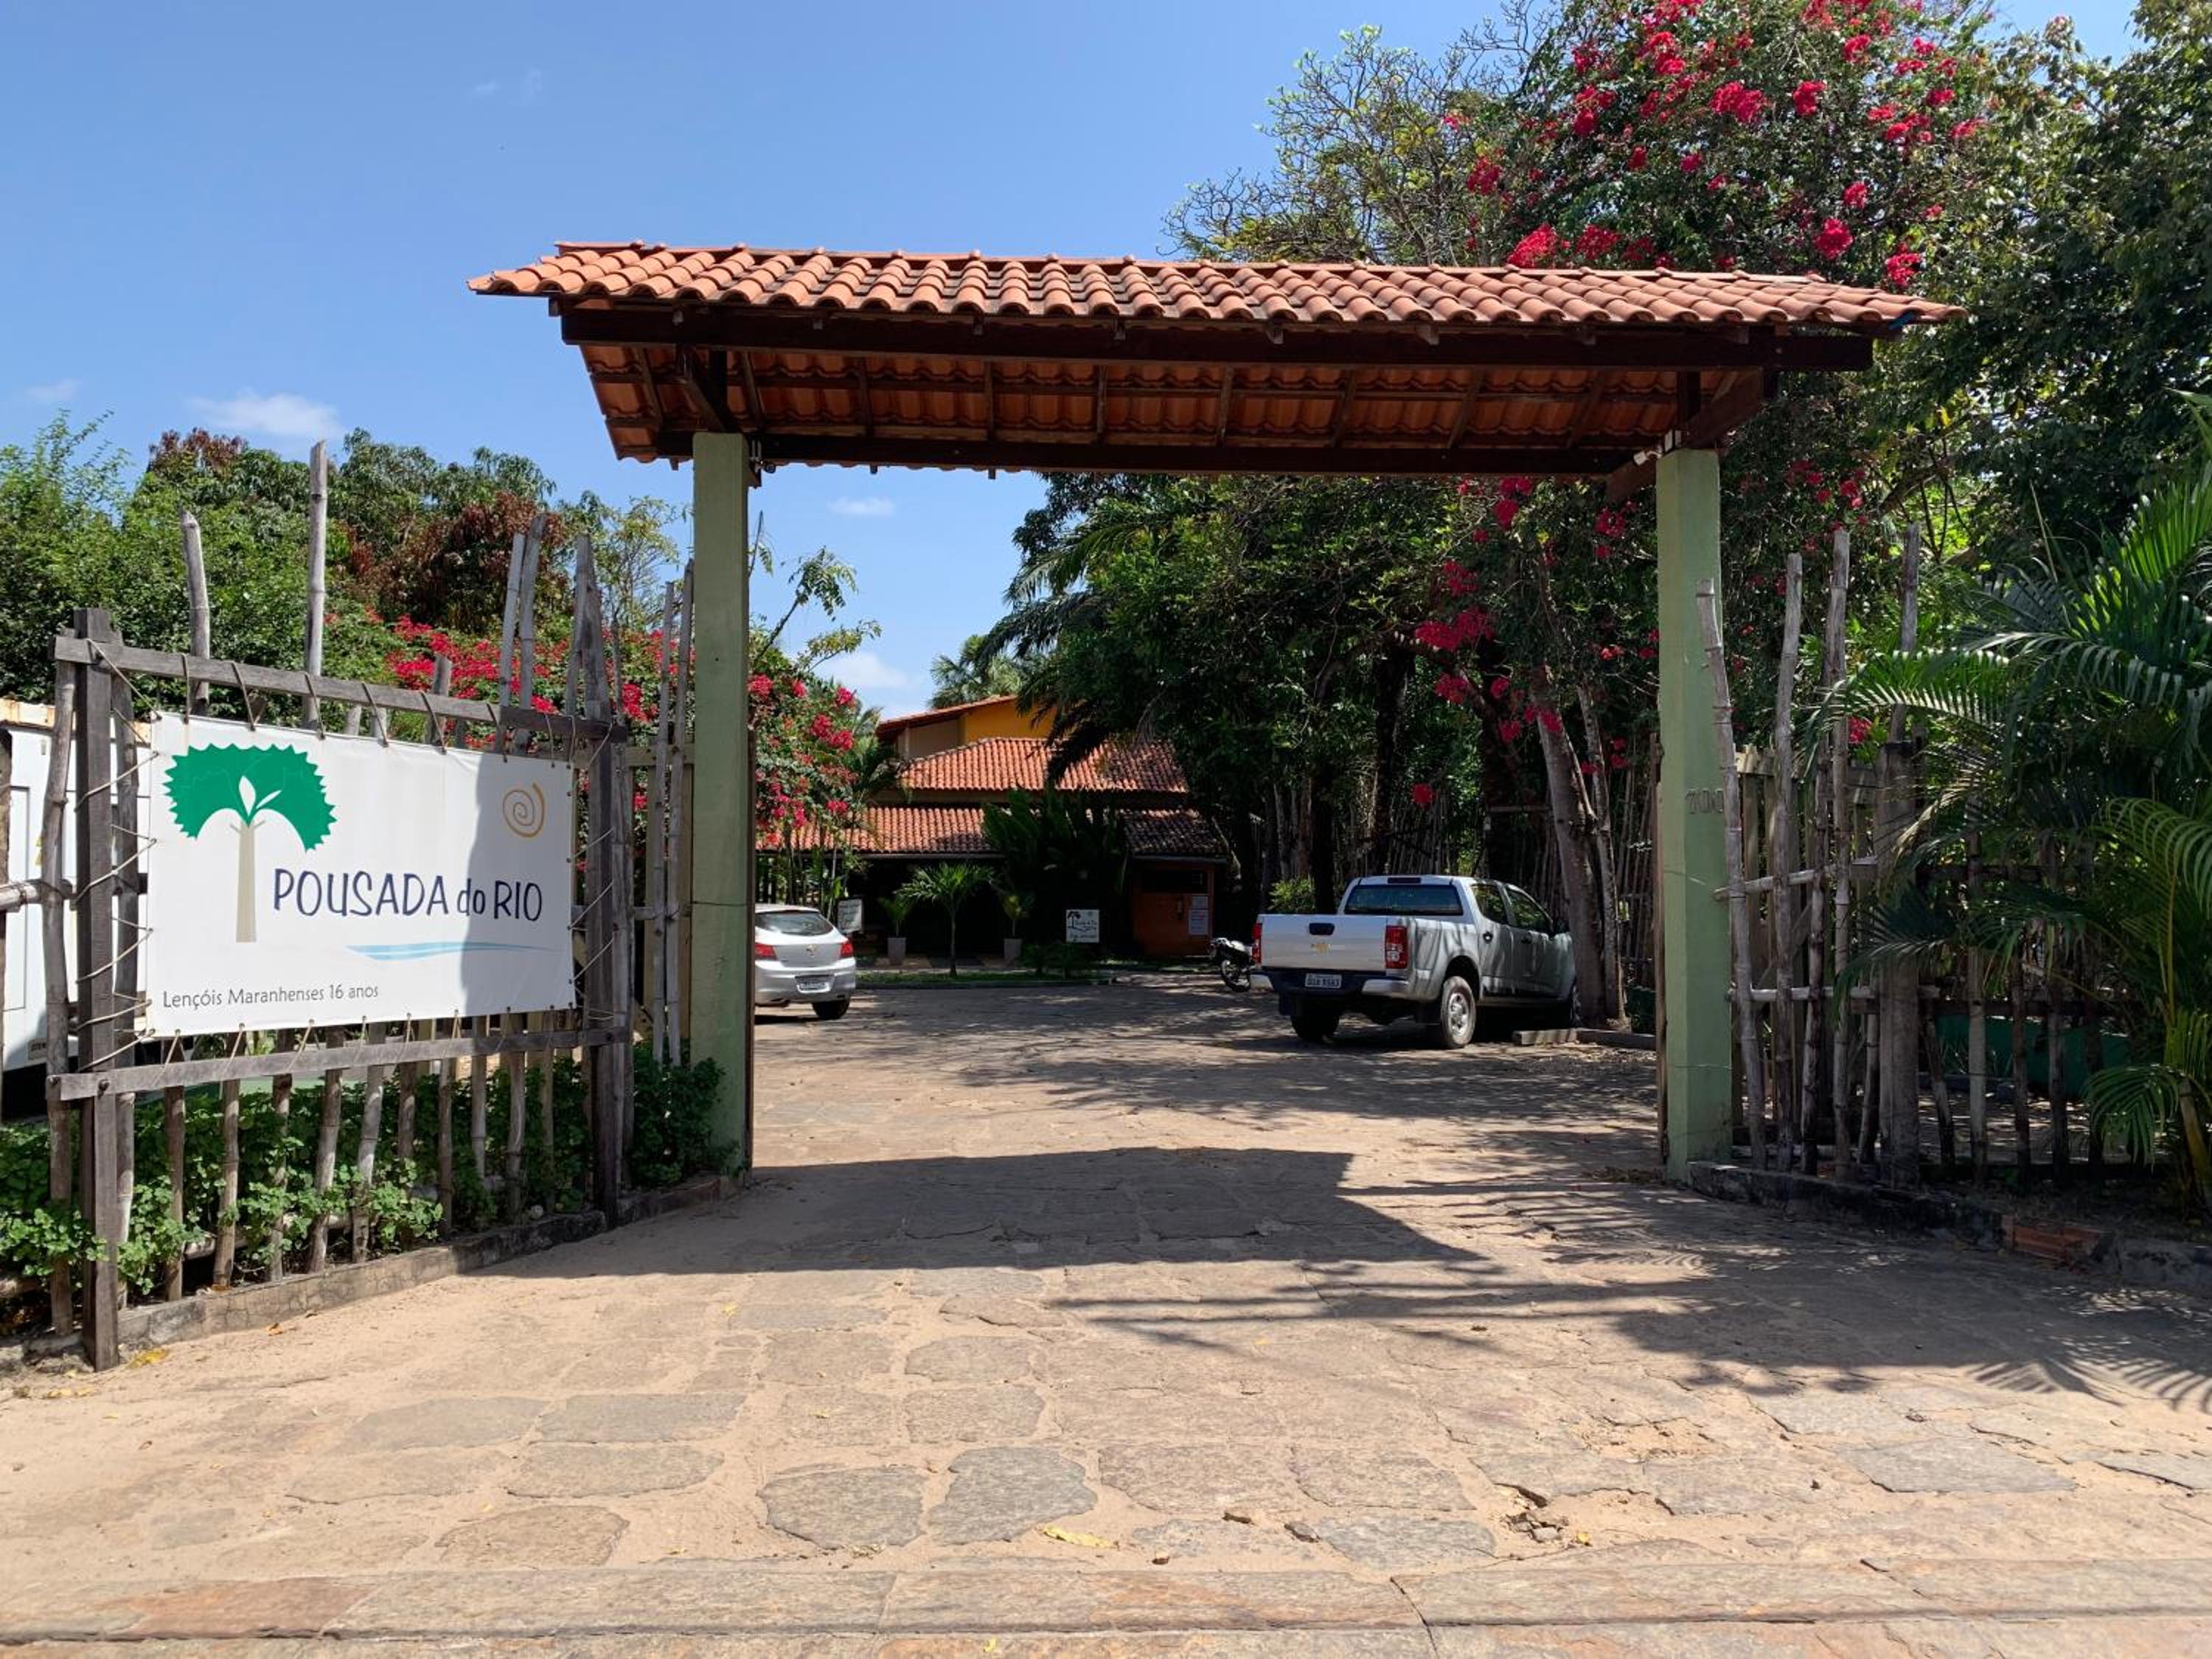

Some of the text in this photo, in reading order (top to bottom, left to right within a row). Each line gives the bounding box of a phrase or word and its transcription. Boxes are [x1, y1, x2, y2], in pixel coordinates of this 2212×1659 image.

[274, 868, 543, 922] POUSADA do RIO
[163, 984, 378, 1010] Lençóis Maranhenses 16 anos
